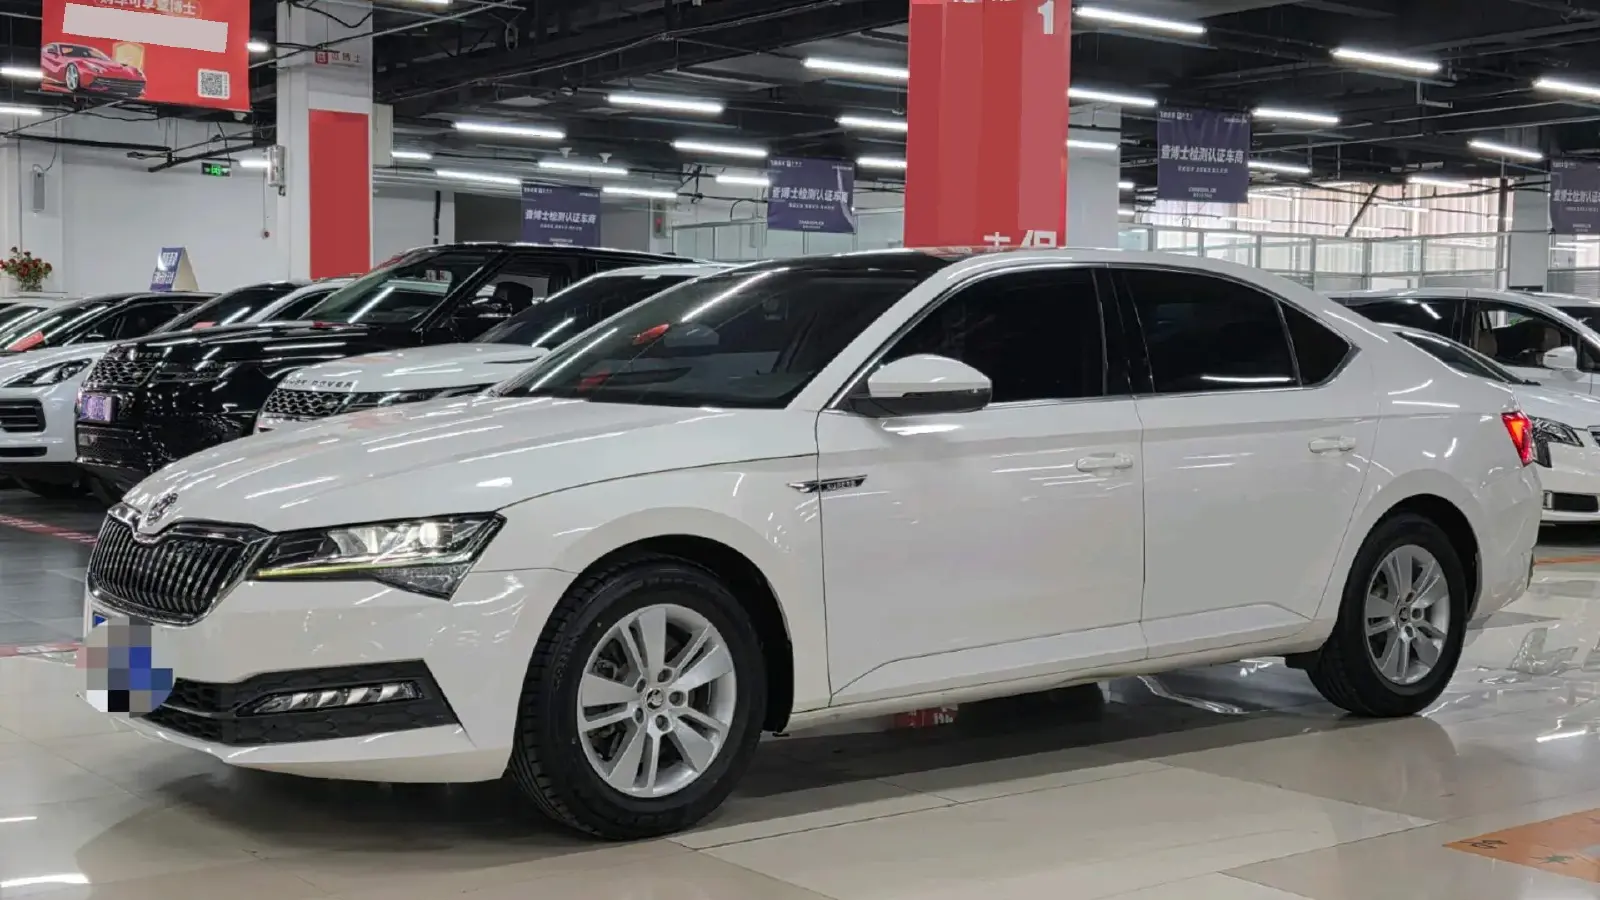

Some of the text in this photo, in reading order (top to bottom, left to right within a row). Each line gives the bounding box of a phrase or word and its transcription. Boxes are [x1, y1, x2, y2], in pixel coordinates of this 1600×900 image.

[1160, 144, 1244, 164] 查博士检测认证车商
[1553, 188, 1600, 203] 查博士检测认证
